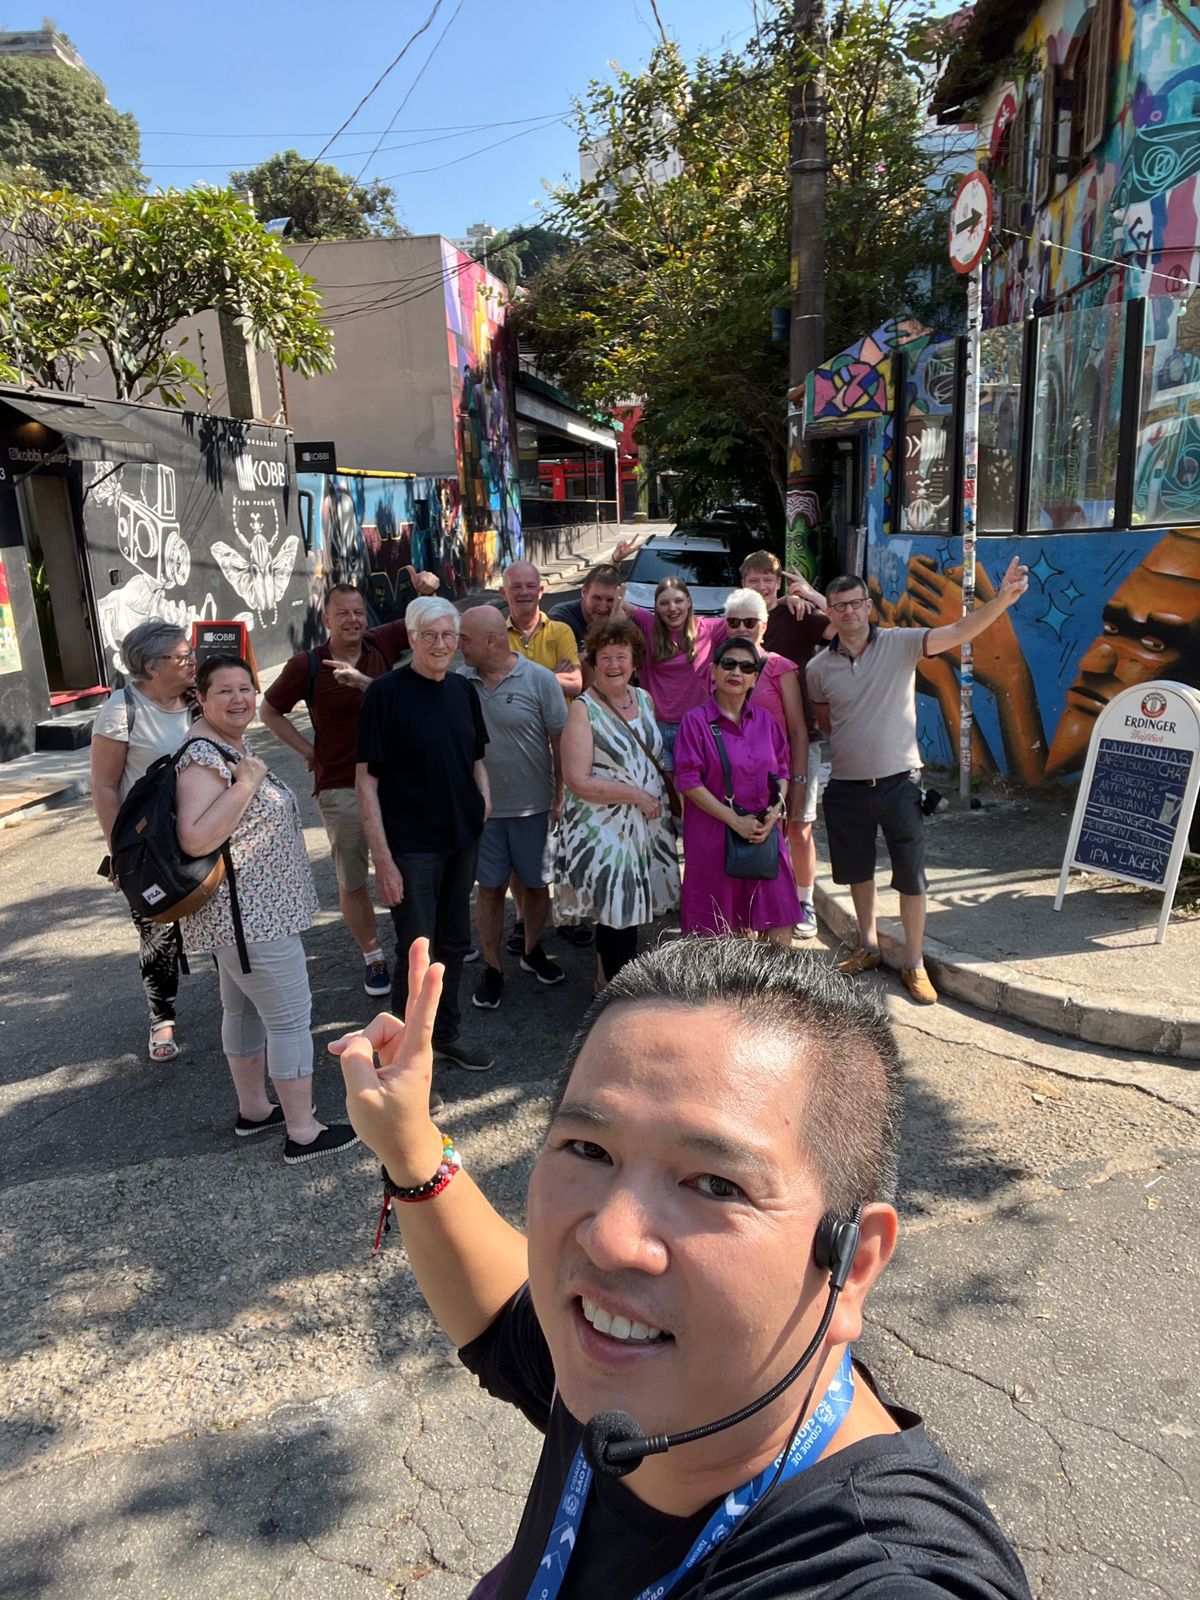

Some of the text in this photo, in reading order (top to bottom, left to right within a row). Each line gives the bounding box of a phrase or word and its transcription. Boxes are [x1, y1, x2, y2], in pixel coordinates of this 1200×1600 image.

[310, 452, 330, 461] KOBBI
[253, 460, 290, 487] KOBBI
[213, 632, 236, 642] KOBBI
[1124, 715, 1176, 734] ERDINGER
[1111, 772, 1154, 792] CERVEJAS
[1119, 852, 1160, 873] LAGER
[791, 1425, 822, 1467] CIDADE DE
[571, 1459, 582, 1490] CIDADE
